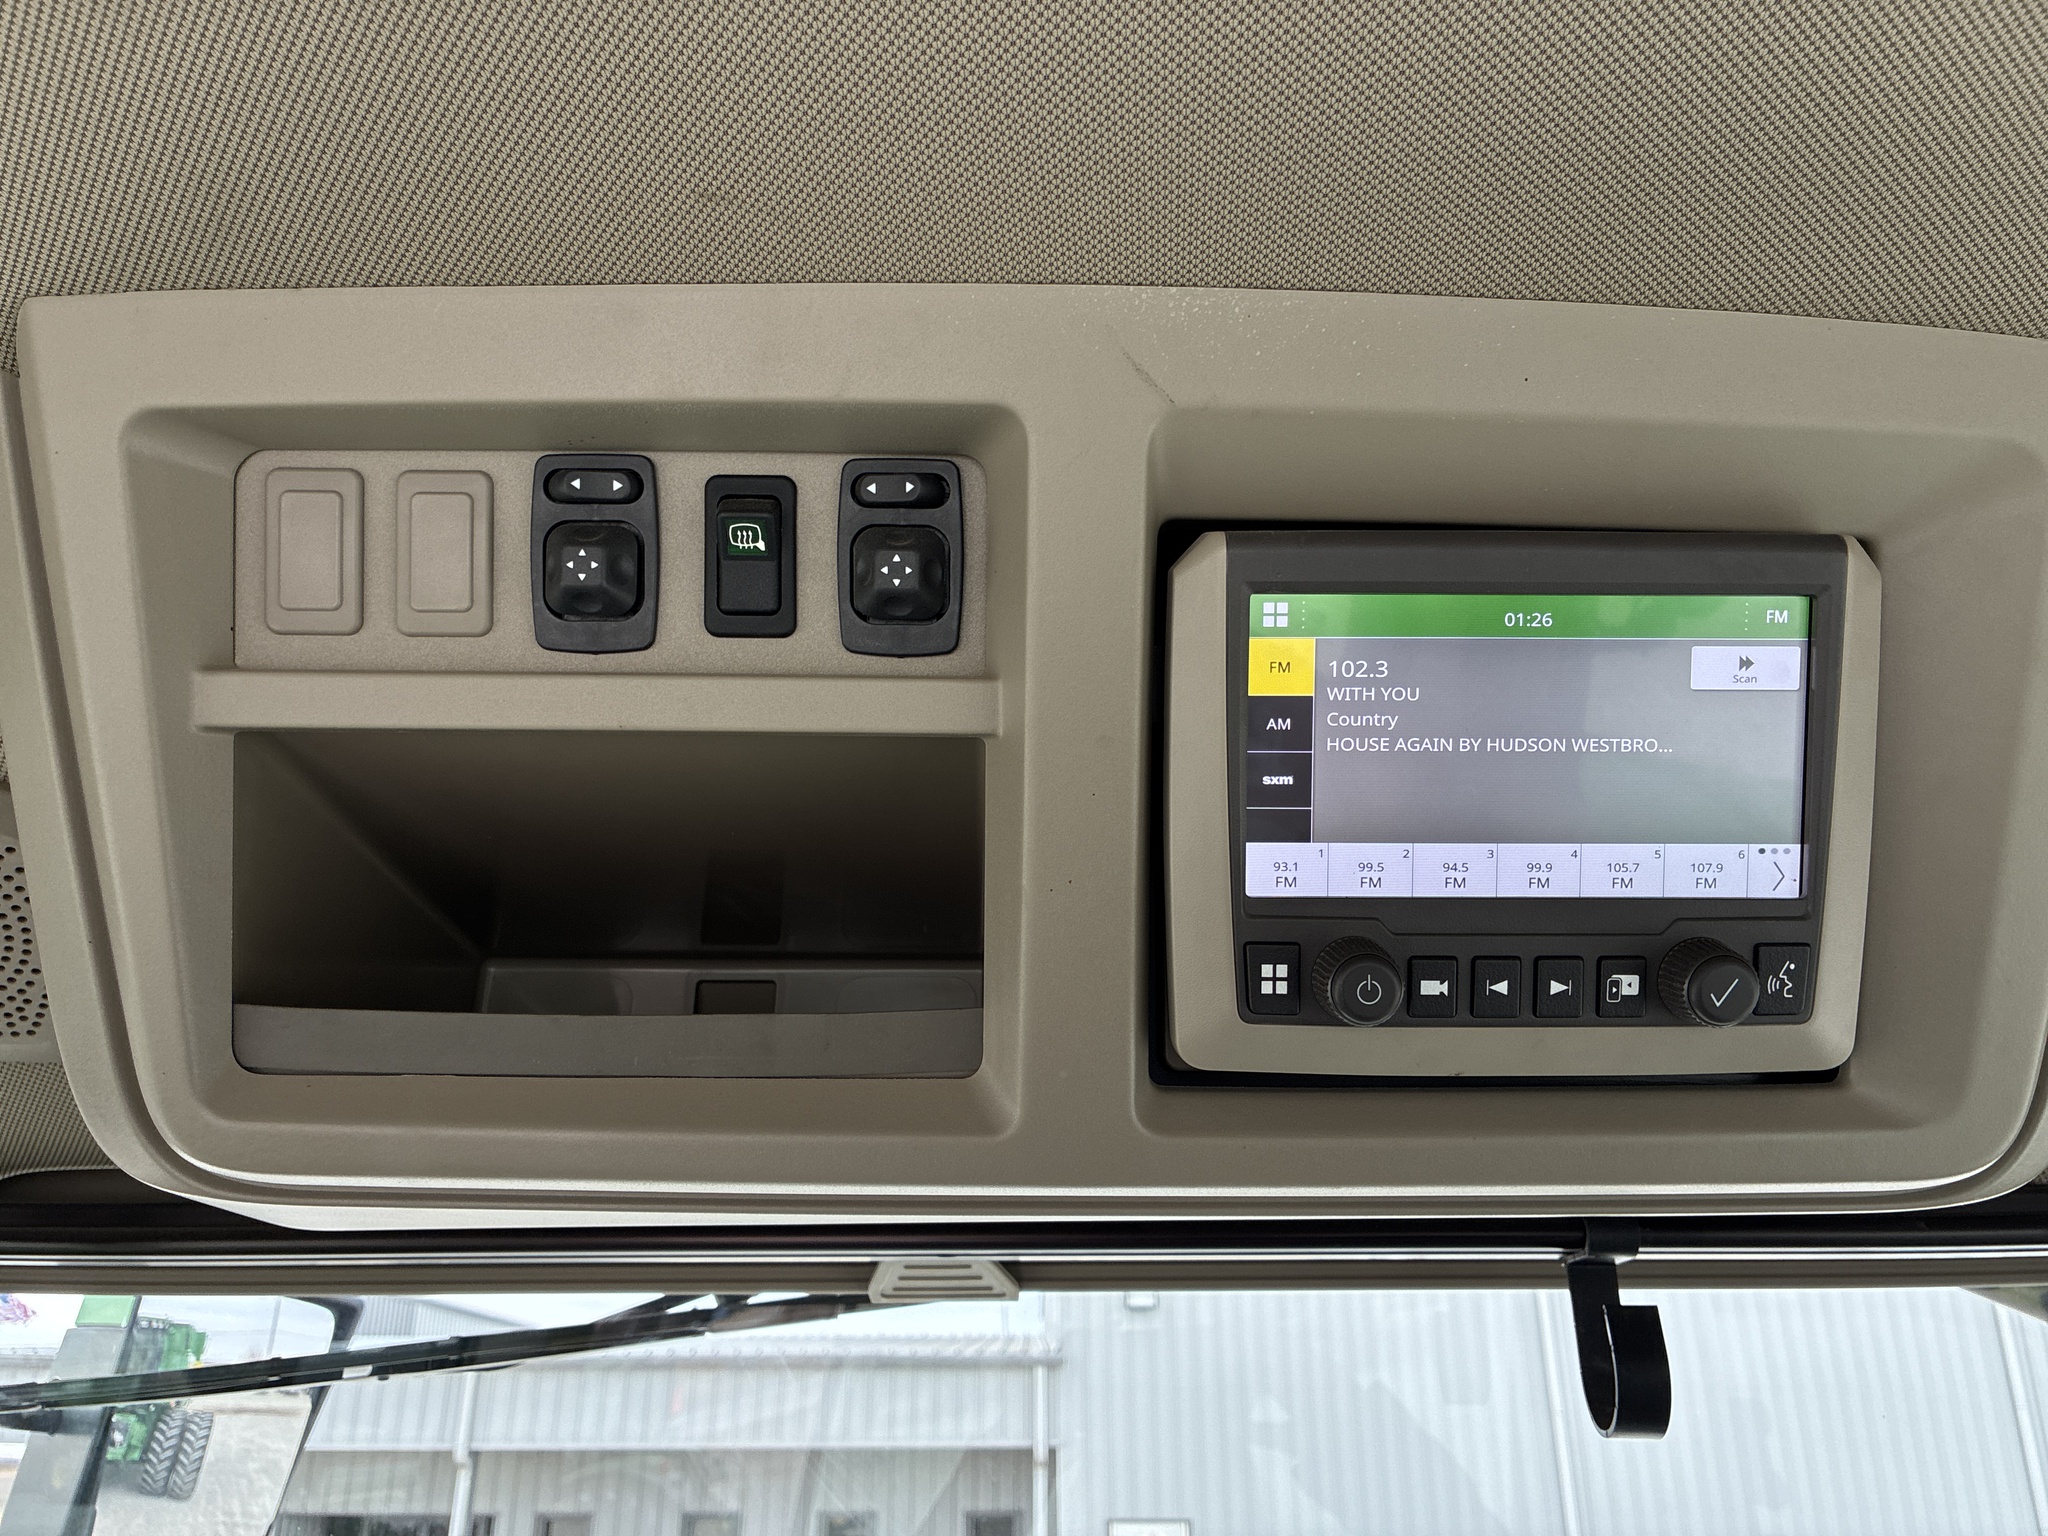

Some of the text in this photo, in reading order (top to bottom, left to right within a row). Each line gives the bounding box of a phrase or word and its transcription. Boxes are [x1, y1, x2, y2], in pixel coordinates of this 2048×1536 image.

[1504, 612, 1553, 627] 01:26
[1766, 609, 1789, 624] FM
[1269, 661, 1291, 674] FM
[1328, 660, 1389, 678] 102.3
[1732, 674, 1758, 684] Scan
[1326, 686, 1420, 702] WITH YOU
[1265, 717, 1291, 731] AM
[1326, 711, 1399, 731] Country
[1326, 737, 1673, 754] HOUSE AGAIN BY HUDSON WESTBRO...
[1262, 775, 1294, 785] sxm
[1317, 848, 1324, 859] 1
[1402, 849, 1410, 859] 2
[1486, 849, 1495, 859] 3
[1570, 849, 1578, 859] 4
[1654, 849, 1662, 860] 5
[1738, 849, 1746, 860] 6
[1273, 861, 1298, 872] 93.1
[1357, 861, 1385, 873] 99.5
[1442, 862, 1469, 873] 94.5
[1526, 862, 1553, 873] 99.9
[1606, 862, 1640, 873] 105.7
[1690, 862, 1724, 874] 107.9
[1275, 876, 1297, 888] FM
[1360, 876, 1382, 889] FM
[1444, 876, 1466, 889] FM
[1528, 877, 1550, 889] FM
[1612, 877, 1634, 889] FM
[1695, 877, 1717, 889] FM
